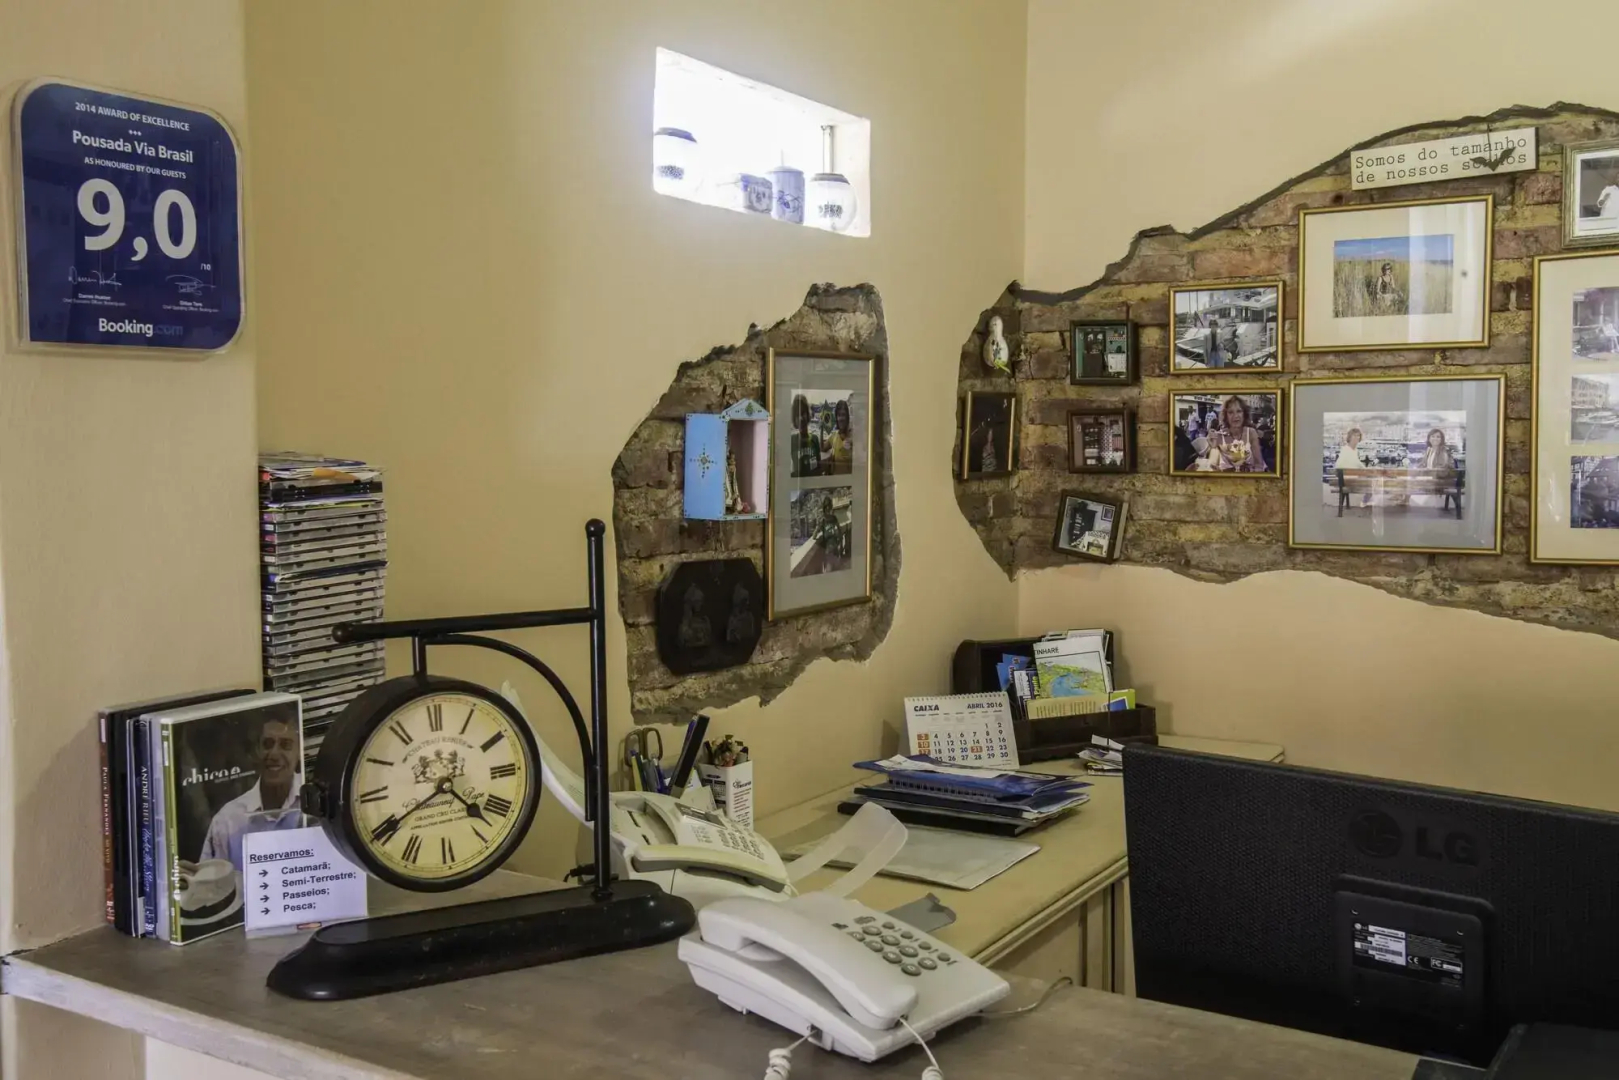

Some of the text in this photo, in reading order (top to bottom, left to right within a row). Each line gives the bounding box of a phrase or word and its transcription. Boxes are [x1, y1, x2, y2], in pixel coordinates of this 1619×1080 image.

[75, 102, 190, 131] 2014 AWARD OF EXCELLENCE
[72, 130, 194, 162] Pousada Via Brasil
[1356, 136, 1527, 169] Somos do tamanho
[84, 156, 94, 164] AS
[95, 158, 135, 171] HONOURED
[146, 166, 160, 175] OUR
[162, 169, 186, 179] GUESTS
[1356, 171, 1375, 184] de
[1386, 164, 1449, 180] nossos
[77, 178, 197, 260] 9,0
[914, 704, 940, 712] CAIXA
[250, 848, 314, 862] Reservamos:
[1416, 826, 1478, 867] LG
[281, 862, 331, 875] Catamarã;
[282, 872, 356, 888] Semi-Terrestre;
[282, 888, 330, 900] Passeios;
[283, 902, 316, 912] Pesca;
